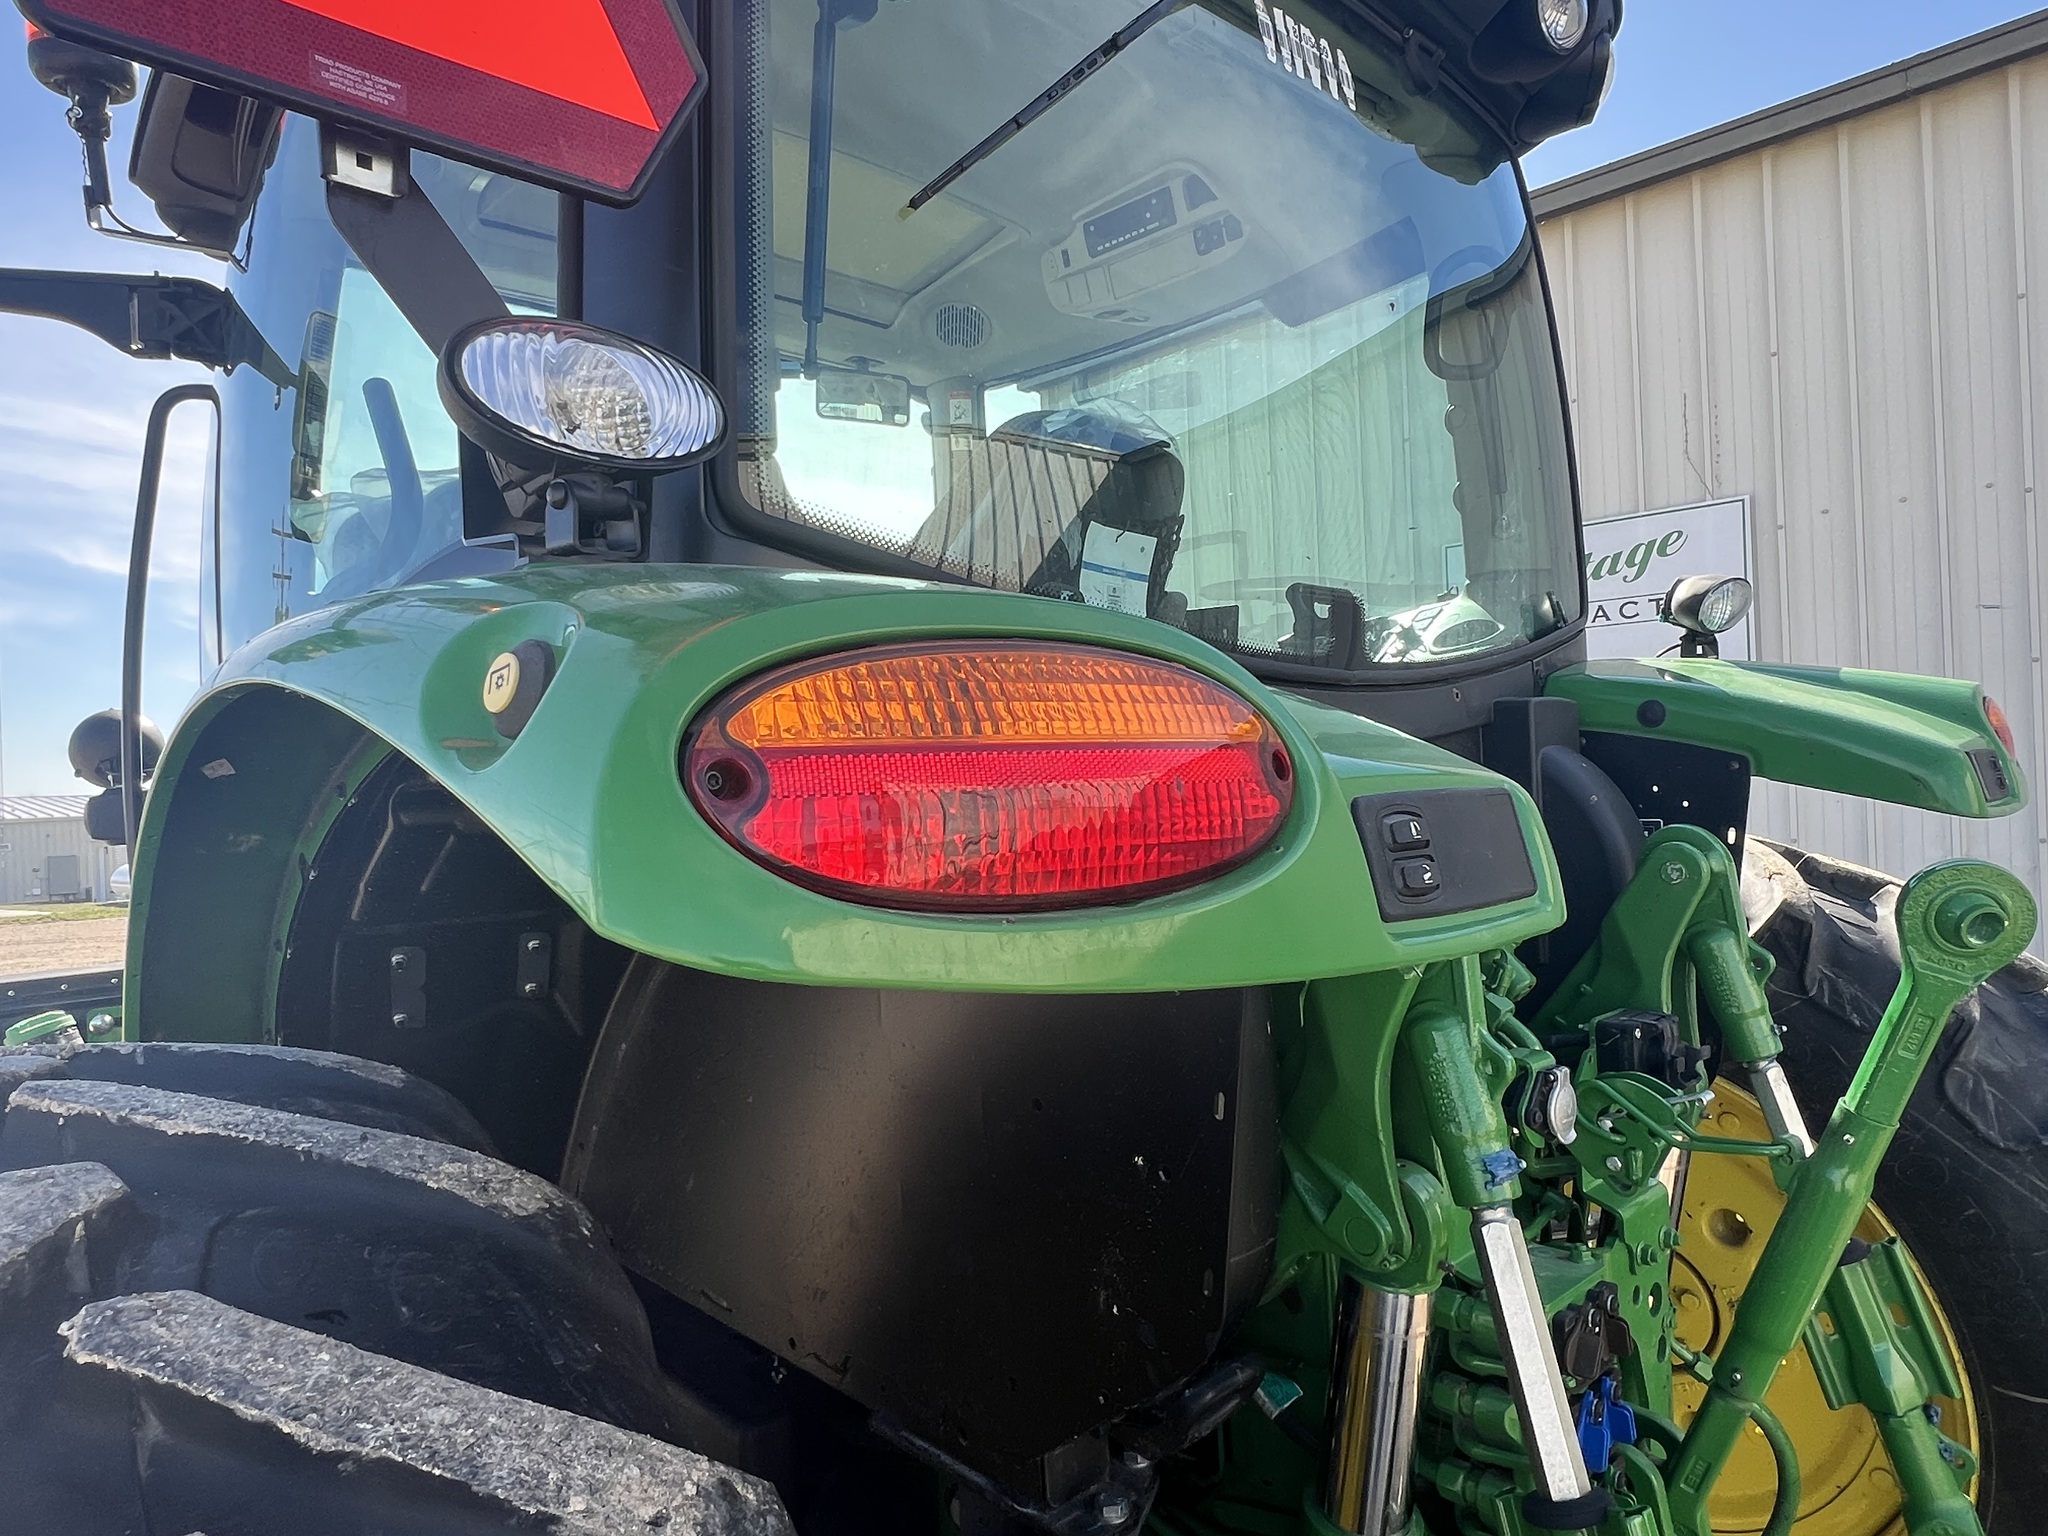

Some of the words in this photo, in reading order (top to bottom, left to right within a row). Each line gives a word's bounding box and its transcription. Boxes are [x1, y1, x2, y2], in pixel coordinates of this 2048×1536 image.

[314, 54, 334, 66] TRIAD
[335, 62, 370, 79] PRODUCTS
[371, 74, 401, 89] COMPANY
[321, 71, 354, 87] CERTIFIED
[355, 82, 396, 101] COMPLIANCE
[329, 81, 346, 91] WITH
[375, 83, 388, 92] USA
